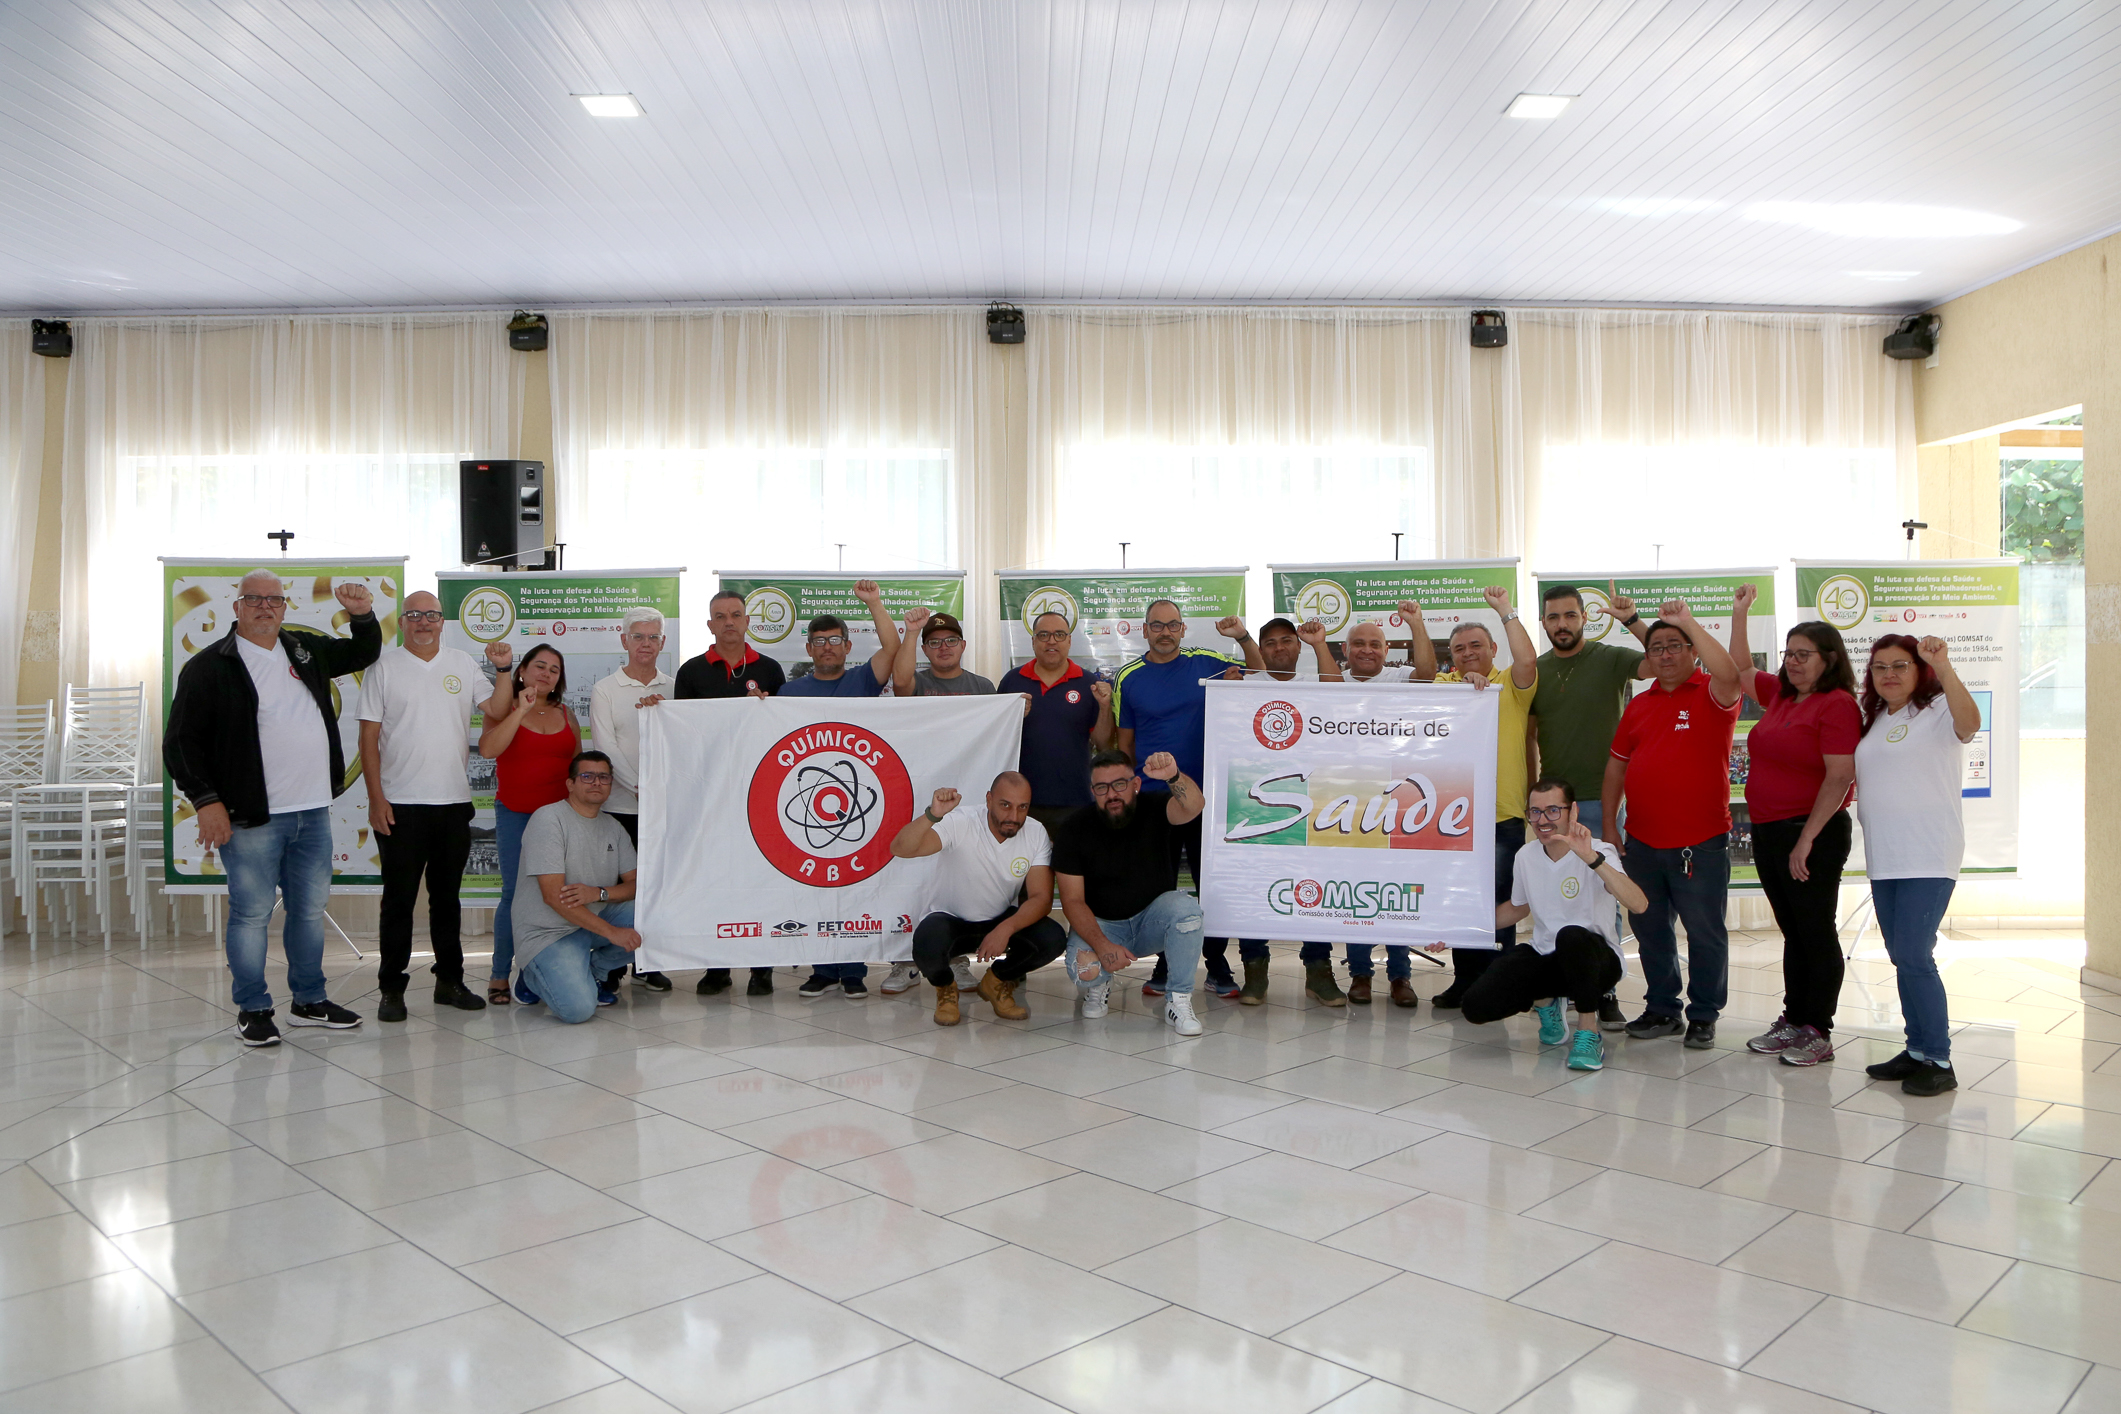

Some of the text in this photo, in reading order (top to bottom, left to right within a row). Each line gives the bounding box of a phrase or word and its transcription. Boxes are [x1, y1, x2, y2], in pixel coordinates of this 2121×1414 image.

[1356, 589, 1398, 597] Segurança
[1824, 587, 1858, 609] 40
[1885, 594, 1929, 602] preservação
[520, 597, 561, 605] Segurança
[1084, 596, 1126, 604] Segurança
[1304, 592, 1340, 615] 40
[468, 598, 505, 622] 40
[748, 599, 785, 622] 40
[1096, 606, 1145, 614] preservação
[1584, 602, 1603, 622] 0
[446, 678, 458, 687] 40
[1262, 702, 1295, 715] QUÍMICOS
[1308, 716, 1450, 737] Secretaria de
[778, 728, 884, 767] QUÍMICOS
[1224, 768, 1470, 841] Saúde
[1013, 861, 1027, 870] 40
[1564, 881, 1576, 890] 40
[1268, 878, 1424, 918] COMSAT
[718, 924, 757, 937] CUT
[817, 918, 882, 932] FETQUIM
